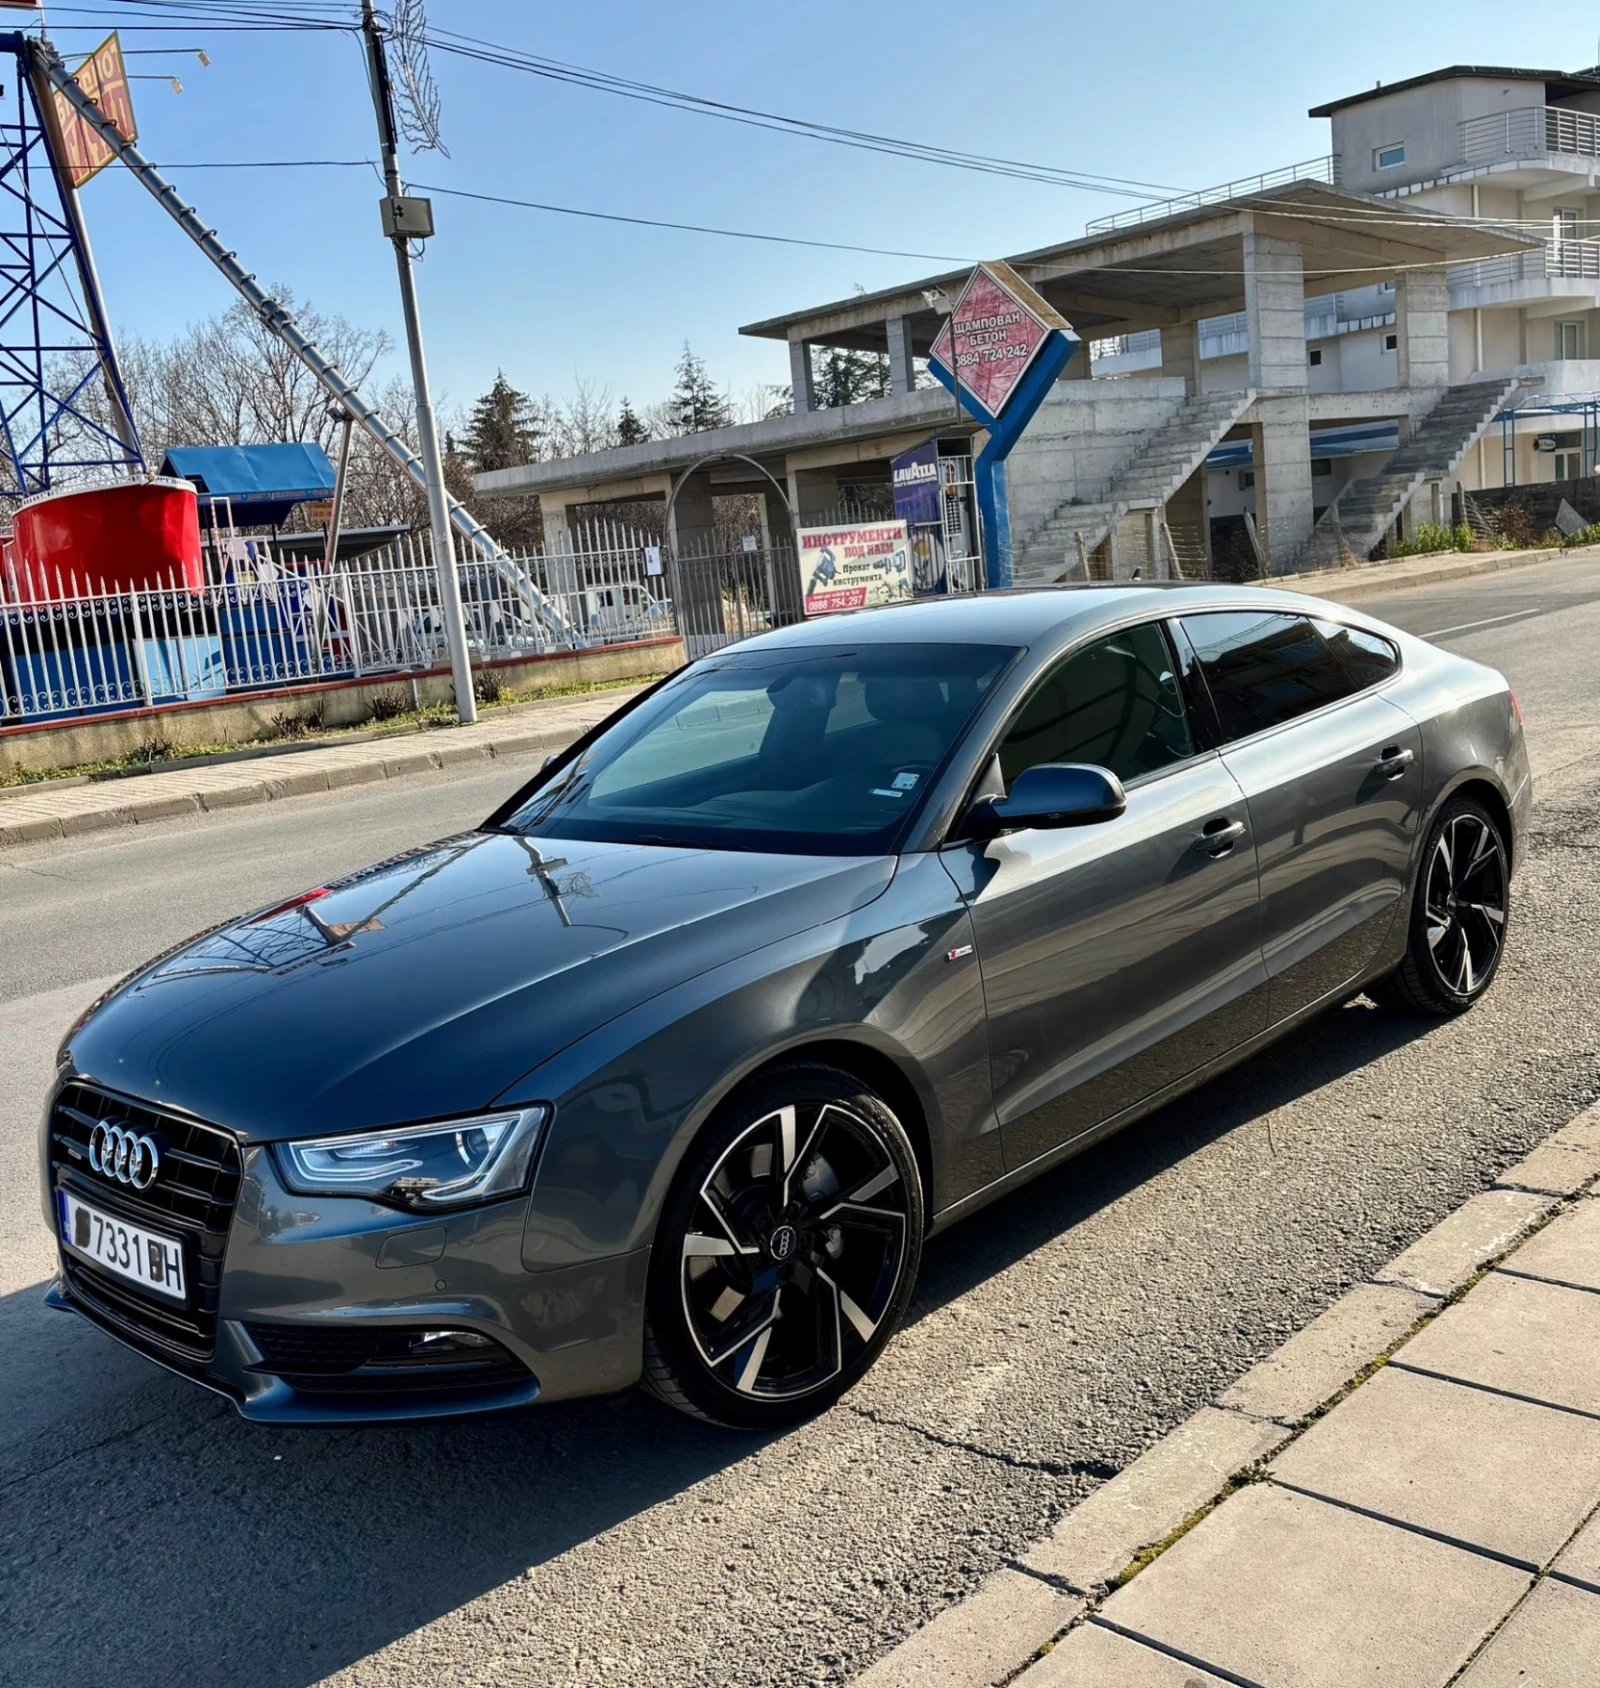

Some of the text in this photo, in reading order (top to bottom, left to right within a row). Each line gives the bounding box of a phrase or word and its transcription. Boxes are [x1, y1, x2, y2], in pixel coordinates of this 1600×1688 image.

[969, 330, 1007, 346] БЕТОН
[983, 349, 1003, 362] 724
[1007, 344, 1028, 358] 242
[893, 461, 937, 482] LAVAZZA
[801, 526, 903, 549] ИНСТРУМЕНТИ
[844, 542, 894, 559] ПОД НАЕМ
[842, 563, 870, 574] Прокат
[832, 573, 882, 586] инструмента
[93, 1214, 142, 1277] 7331
